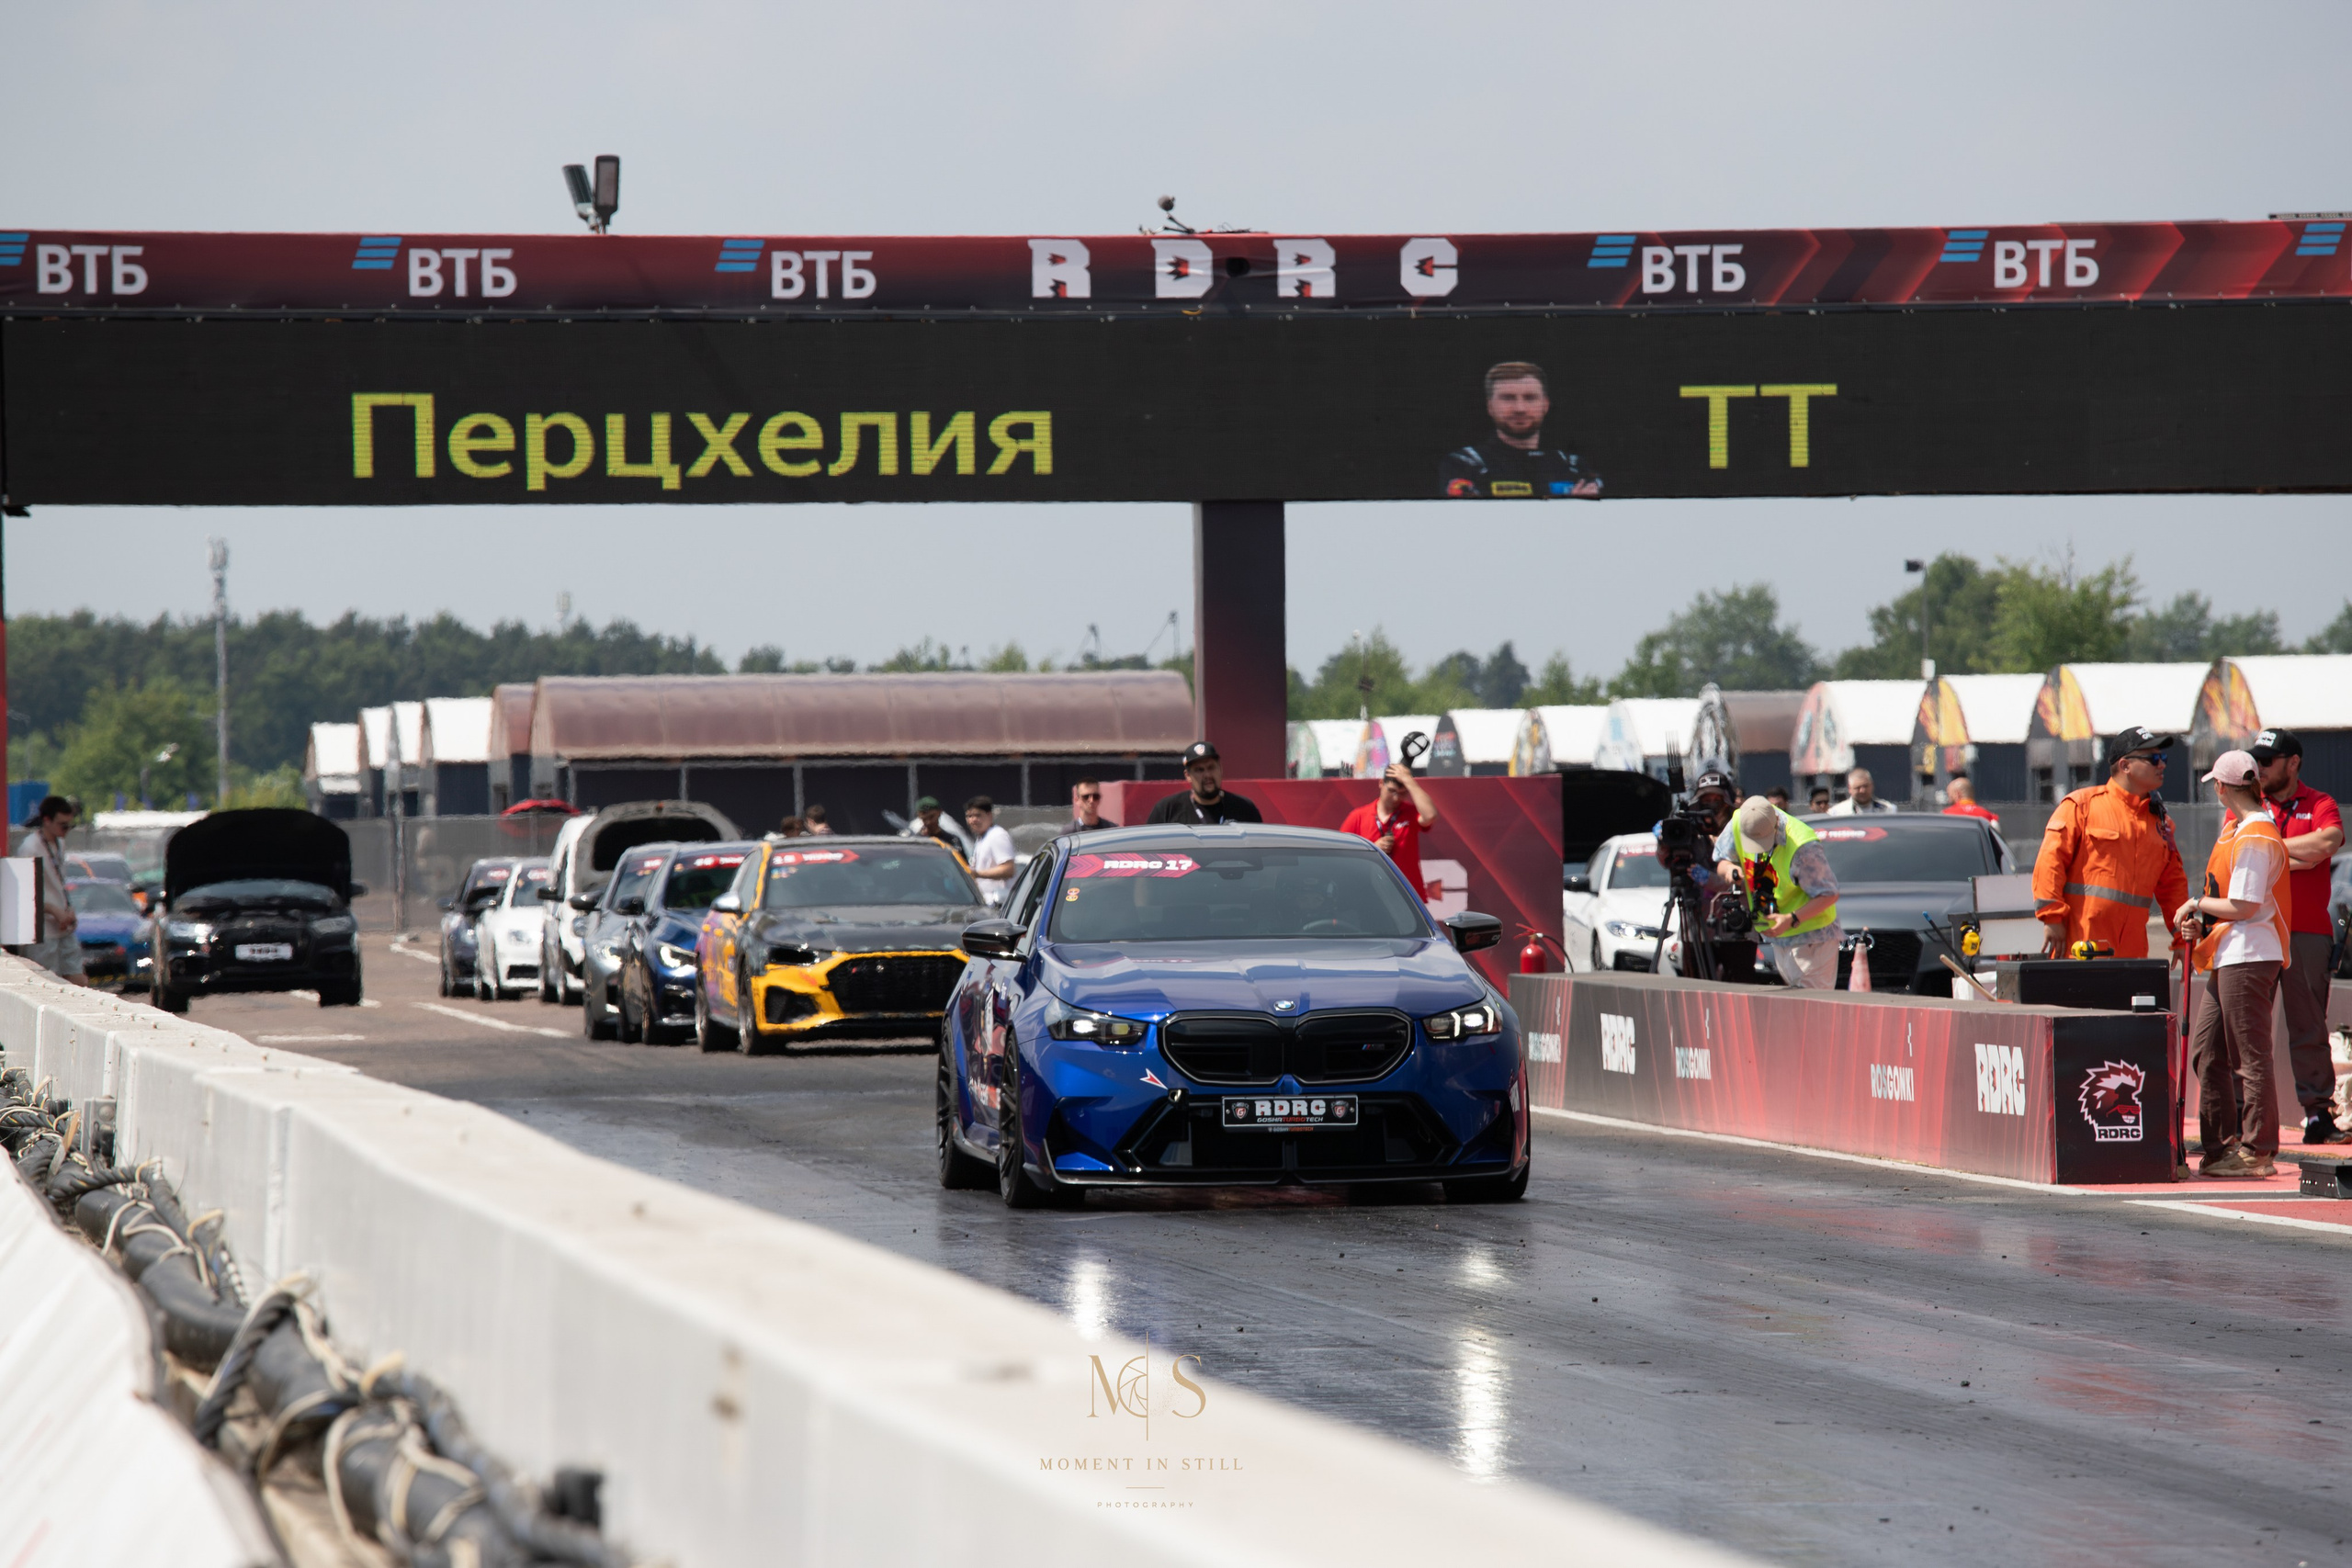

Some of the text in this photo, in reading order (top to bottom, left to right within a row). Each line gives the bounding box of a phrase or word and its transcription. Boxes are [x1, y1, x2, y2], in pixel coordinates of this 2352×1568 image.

[37, 244, 148, 295] ВТБ
[408, 248, 517, 297] ВТБ
[771, 250, 876, 299] ВТБ
[1641, 243, 1746, 294] ВТБ
[1993, 238, 2100, 288] ВТБ
[351, 393, 1053, 491] Перцхелия
[1164, 859, 1193, 871] 17
[1600, 1012, 1636, 1075] RDRC
[1675, 1046, 1712, 1080] ROSGONKI
[1870, 1063, 1916, 1102] ROSGONKI
[1974, 1043, 2027, 1116] RDRC
[1254, 1100, 1327, 1116] RDRC
[2098, 1128, 2142, 1139] RDRC
